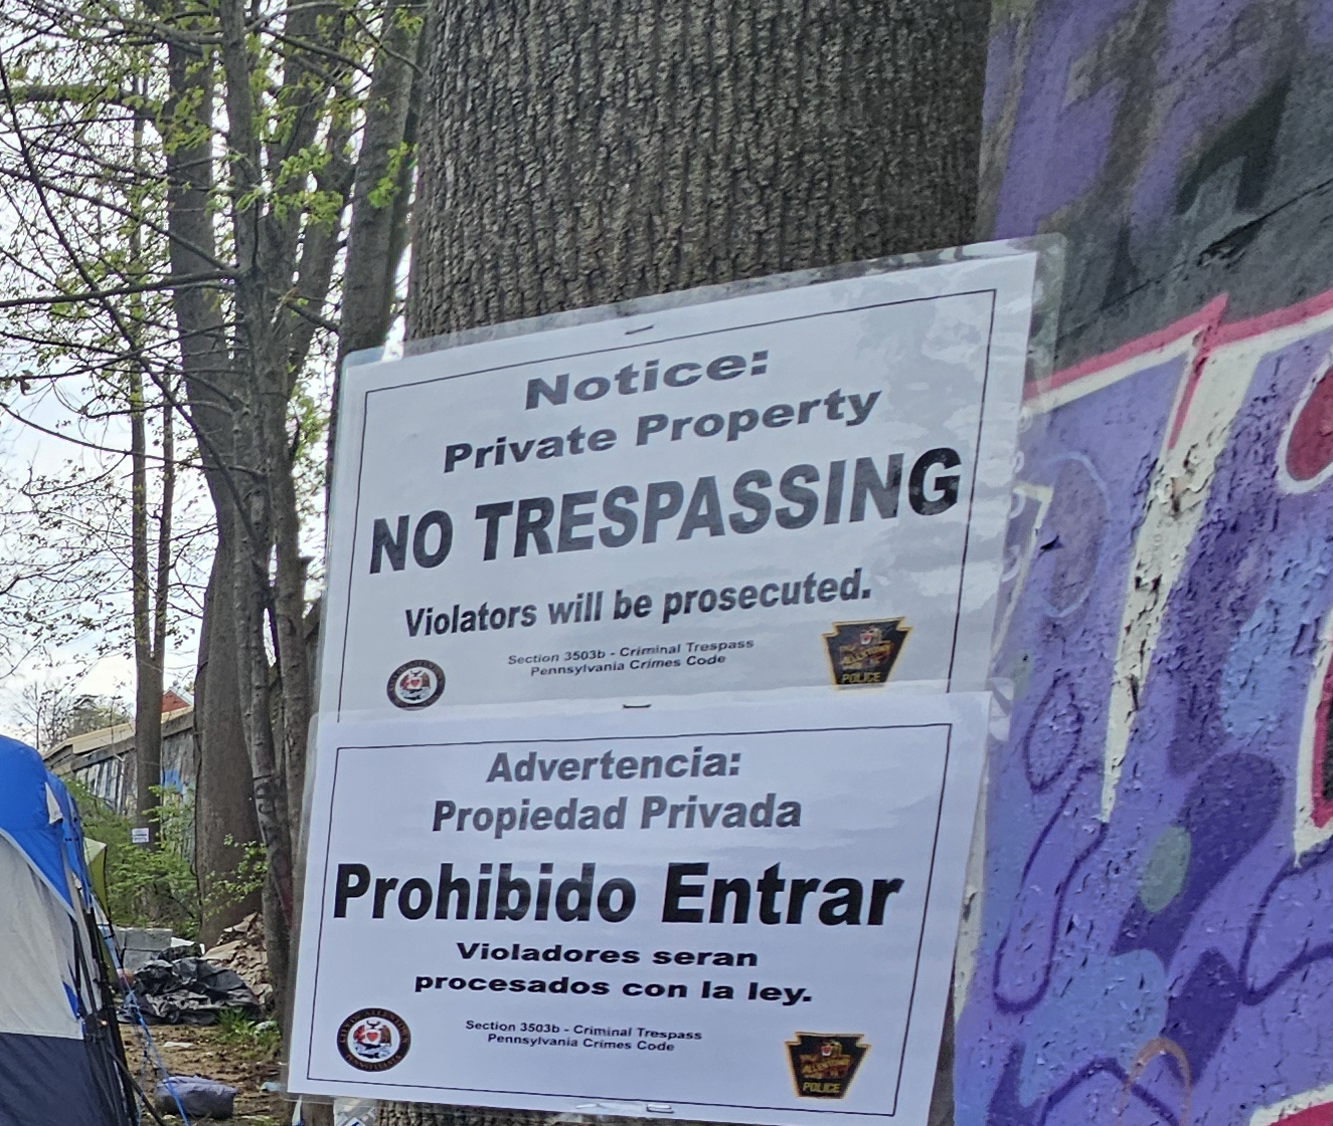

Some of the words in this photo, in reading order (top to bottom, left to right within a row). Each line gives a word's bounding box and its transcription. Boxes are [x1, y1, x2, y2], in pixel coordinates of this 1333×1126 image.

[524, 349, 769, 411] Notice:
[443, 424, 618, 474] Private
[635, 387, 883, 447] Property
[368, 509, 454, 575] NO
[474, 447, 963, 562] TRESPASSING
[404, 601, 538, 638] Violators
[547, 590, 604, 626] will
[612, 588, 653, 621] be
[661, 566, 872, 625] prosecuted.
[507, 653, 560, 666] Section
[563, 649, 606, 662] 3503b
[619, 643, 682, 658] Criminal
[685, 640, 755, 653] Trespass
[530, 660, 625, 677] Pennsylvania
[629, 658, 682, 670] Crimes
[685, 653, 727, 667] Code
[842, 671, 882, 684] POLICE
[485, 745, 742, 784] Advertencia:
[431, 795, 626, 840] Propiedad
[639, 792, 802, 830] Privada
[332, 862, 637, 924] Prohibido
[660, 861, 906, 927] Entrar
[455, 942, 641, 964] Violadores
[651, 950, 759, 967] seran
[414, 975, 611, 996] procesados
[621, 982, 689, 999] con
[700, 980, 735, 1000] la
[747, 981, 813, 1007] ley.
[465, 1019, 516, 1032] Section
[519, 1021, 561, 1034] 3503b
[572, 1024, 633, 1037] Criminal
[636, 1026, 703, 1041] Trespass
[487, 1032, 579, 1048] Pennsylvania
[582, 1037, 633, 1050] Crimes
[636, 1039, 675, 1052] Code
[802, 1081, 842, 1094] POLICE
